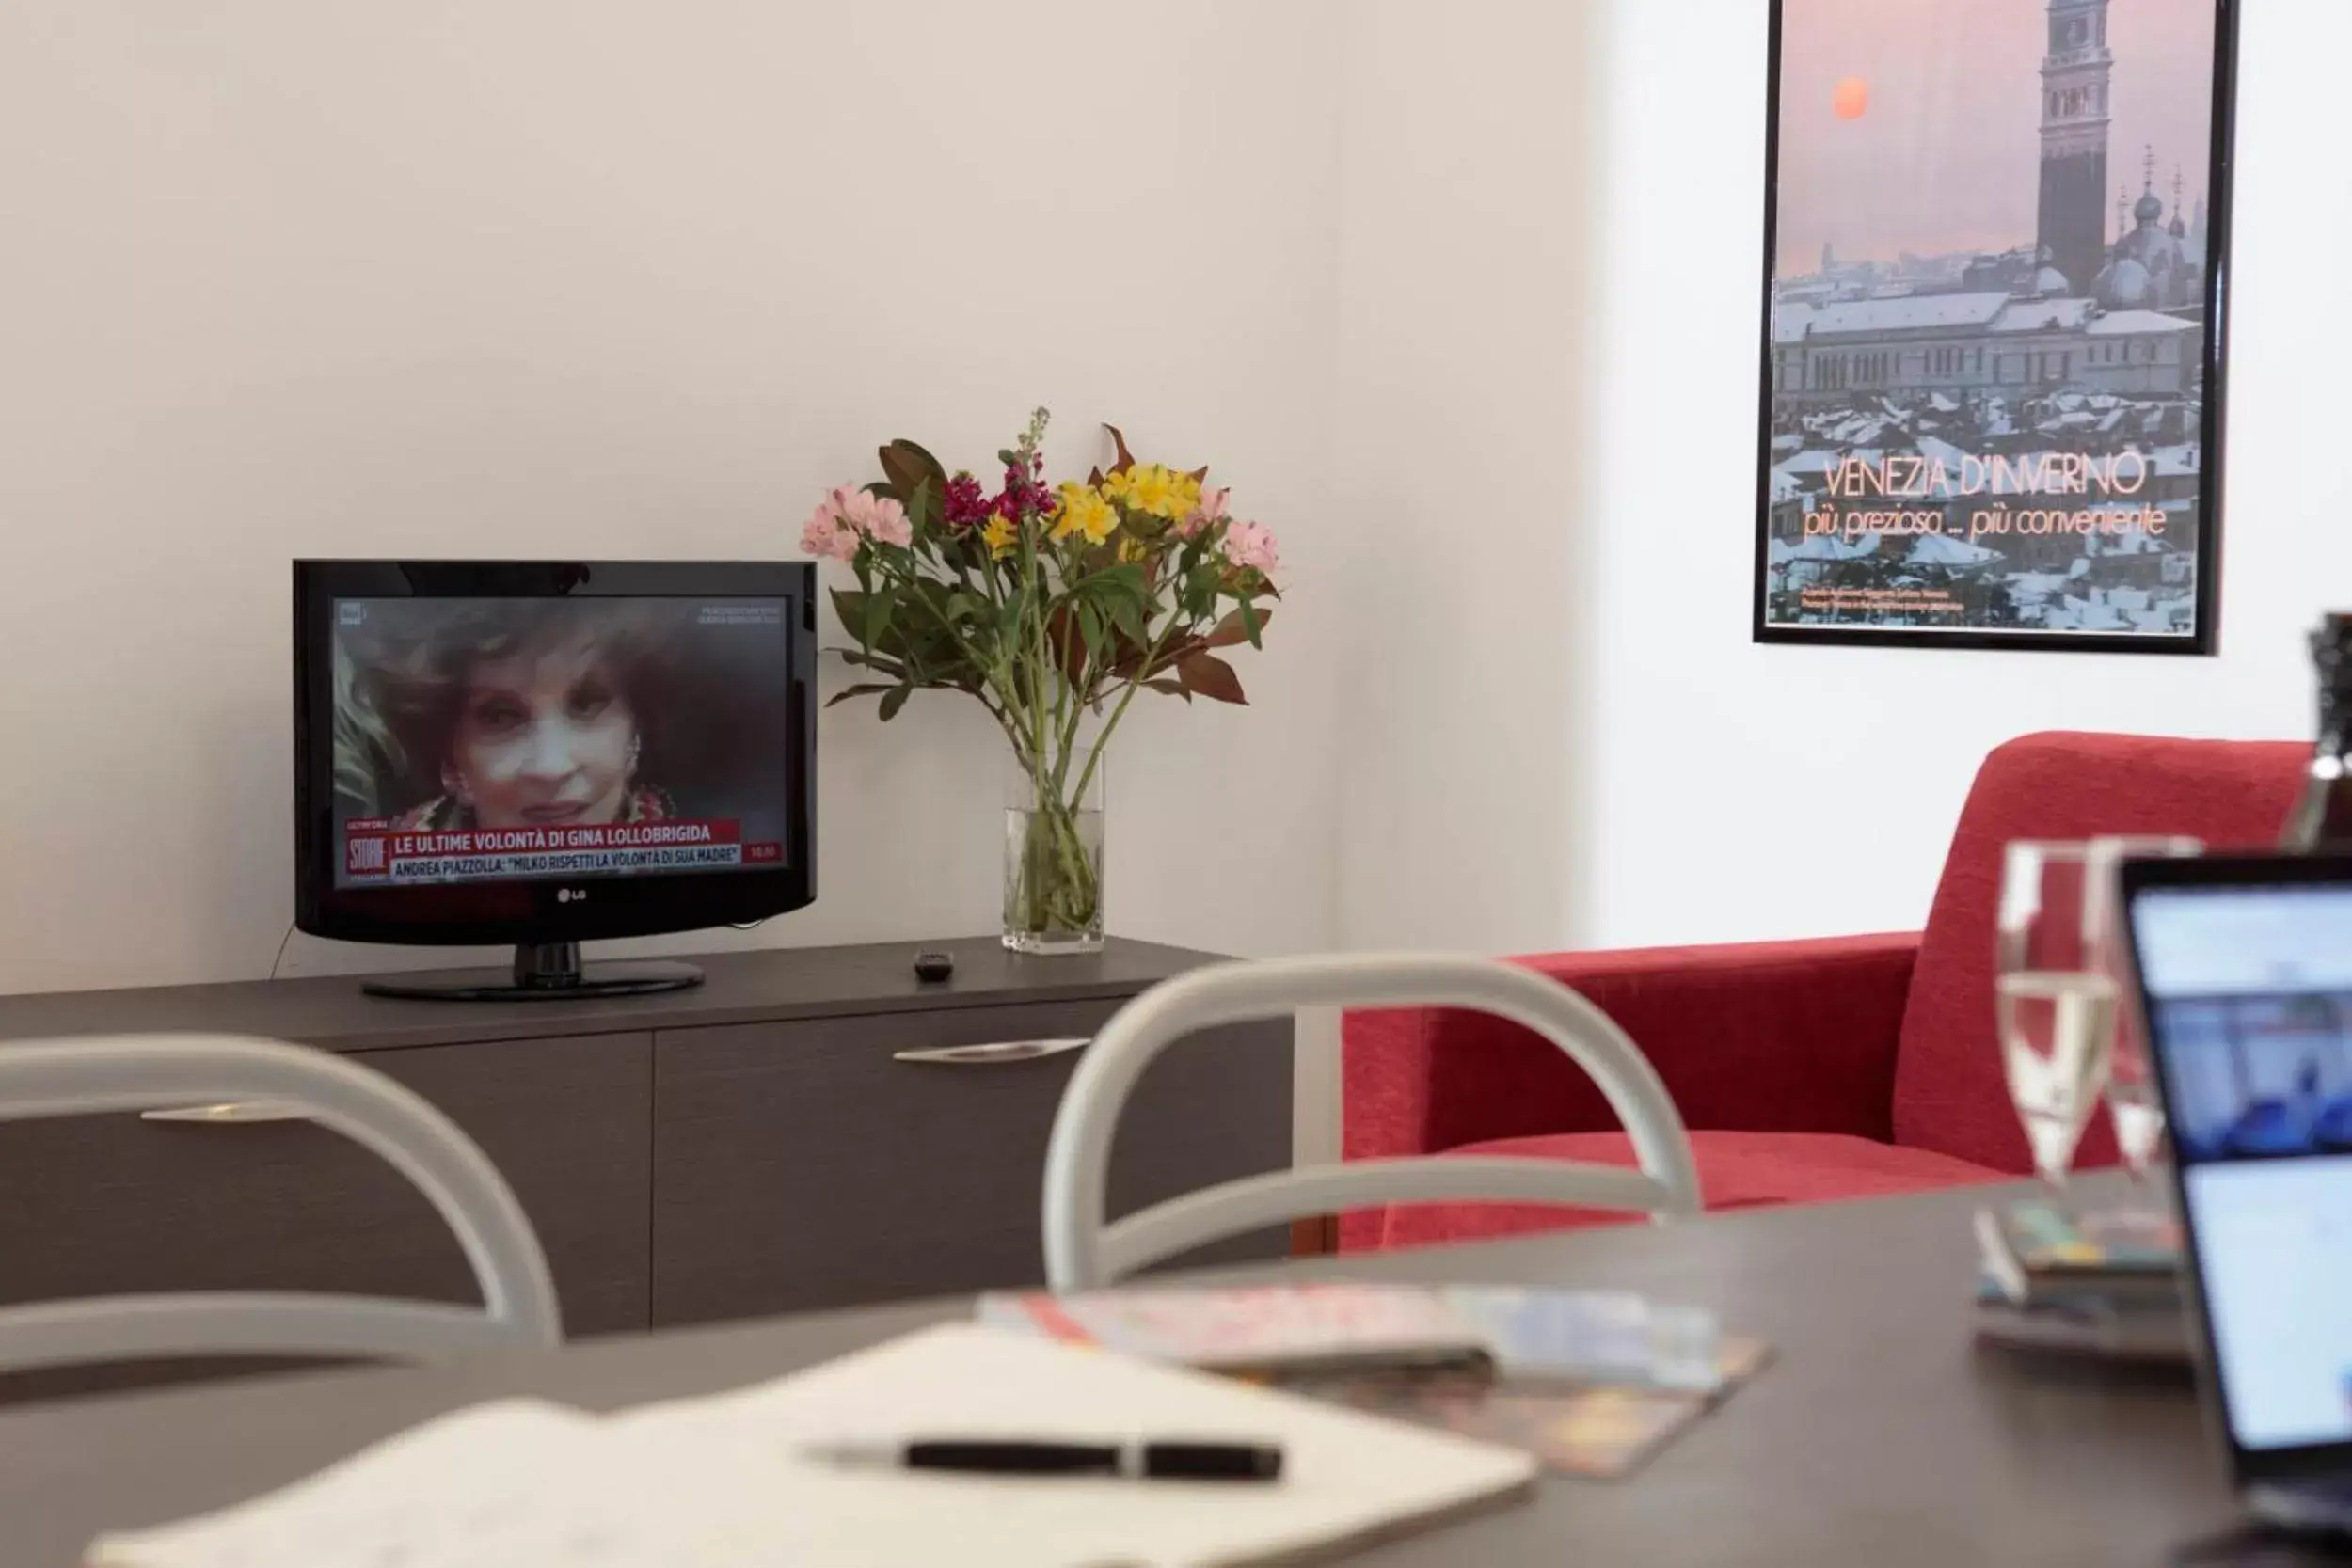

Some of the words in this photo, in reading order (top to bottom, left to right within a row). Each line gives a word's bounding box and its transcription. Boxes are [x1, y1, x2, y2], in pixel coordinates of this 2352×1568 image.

[1823, 456, 1952, 497] VENEZIA
[1961, 451, 2147, 496] D'INVERNO
[1803, 504, 1839, 543] più
[1843, 503, 1944, 544] preziosa
[1969, 502, 2011, 543] più
[2015, 502, 2167, 535] conveniente
[394, 836, 413, 854] LE
[417, 833, 471, 853] ULTIME
[474, 828, 546, 850] VOLONTÀ
[548, 831, 564, 847] DI
[567, 829, 603, 847] GINA
[607, 824, 711, 845] LOLLOBRIGIDA
[395, 860, 440, 876] ANDREA
[548, 853, 594, 871] RISPETTI
[596, 853, 609, 867] LA
[661, 849, 672, 863] DI
[675, 848, 695, 863] SUA
[572, 890, 586, 900] LG
